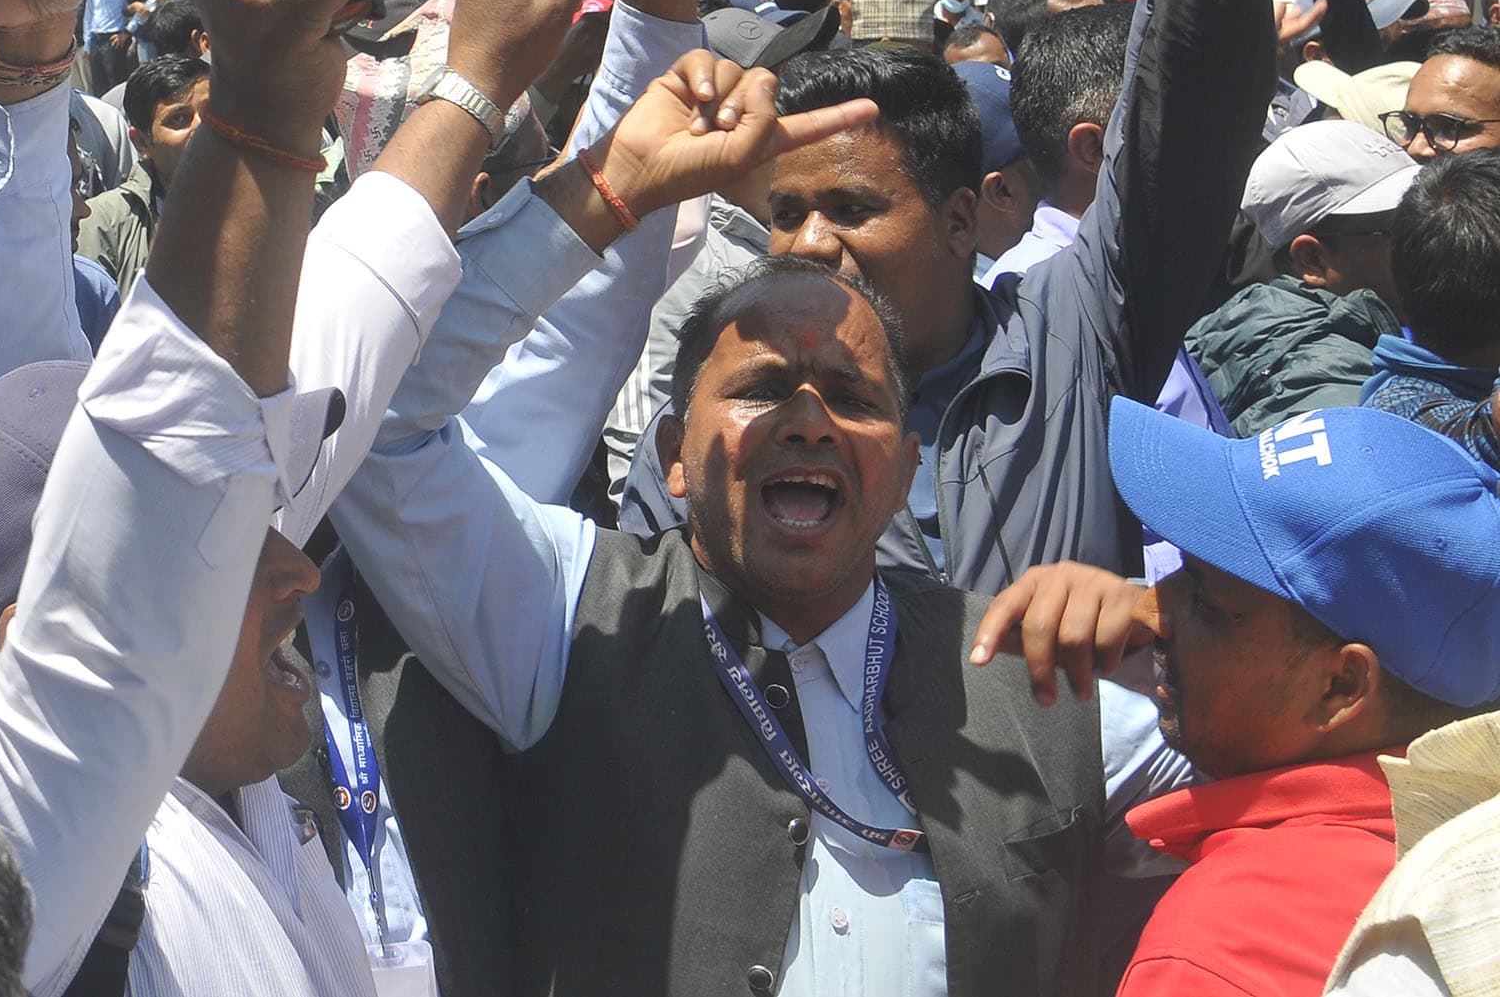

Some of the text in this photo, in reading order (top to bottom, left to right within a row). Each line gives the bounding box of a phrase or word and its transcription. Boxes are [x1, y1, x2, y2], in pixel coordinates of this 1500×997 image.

[864, 637, 885, 733] AADHARBHUT
[358, 772, 369, 785] श्री
[867, 740, 904, 791] SHREE
